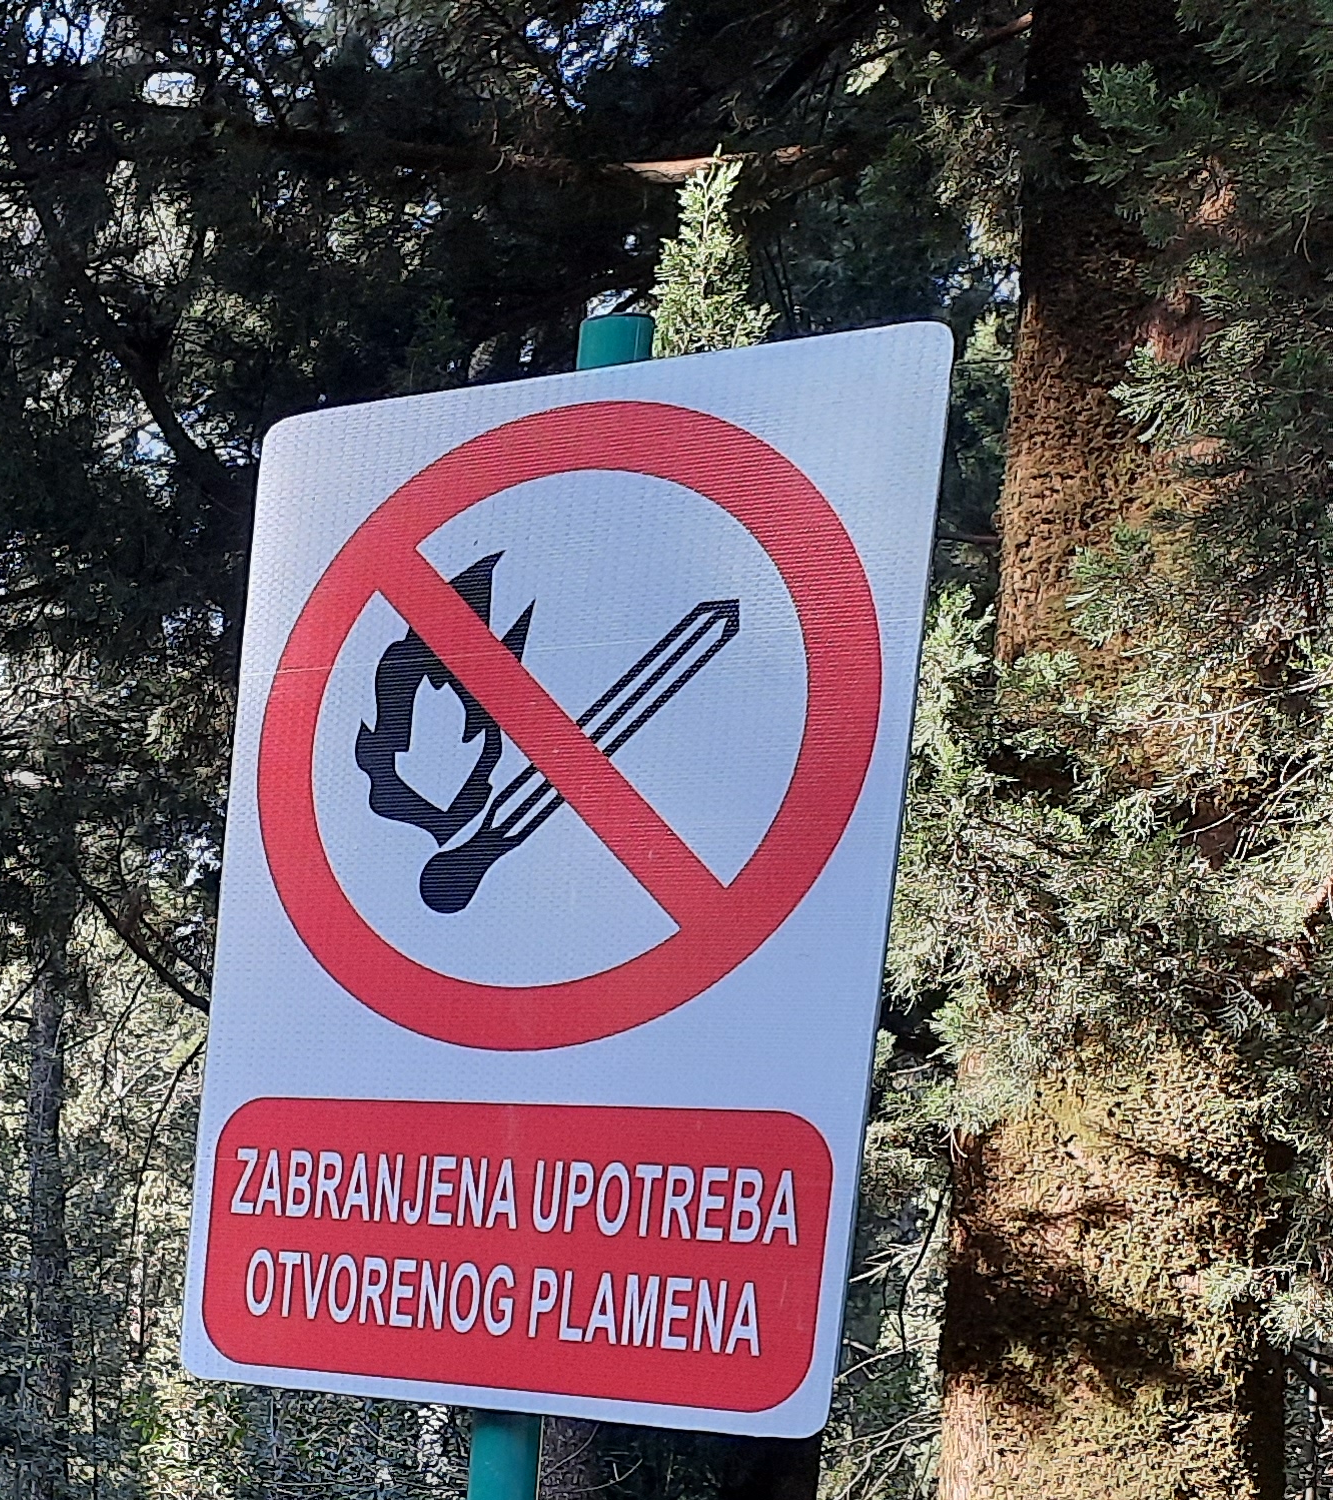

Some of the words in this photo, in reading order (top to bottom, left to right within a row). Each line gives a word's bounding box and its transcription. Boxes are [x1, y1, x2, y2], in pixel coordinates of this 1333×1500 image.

[231, 1147, 517, 1230] ZABRANJENA
[531, 1159, 800, 1246] UPOTREBA
[245, 1247, 515, 1338] OTVORENOG
[527, 1267, 761, 1357] PLAMENA
